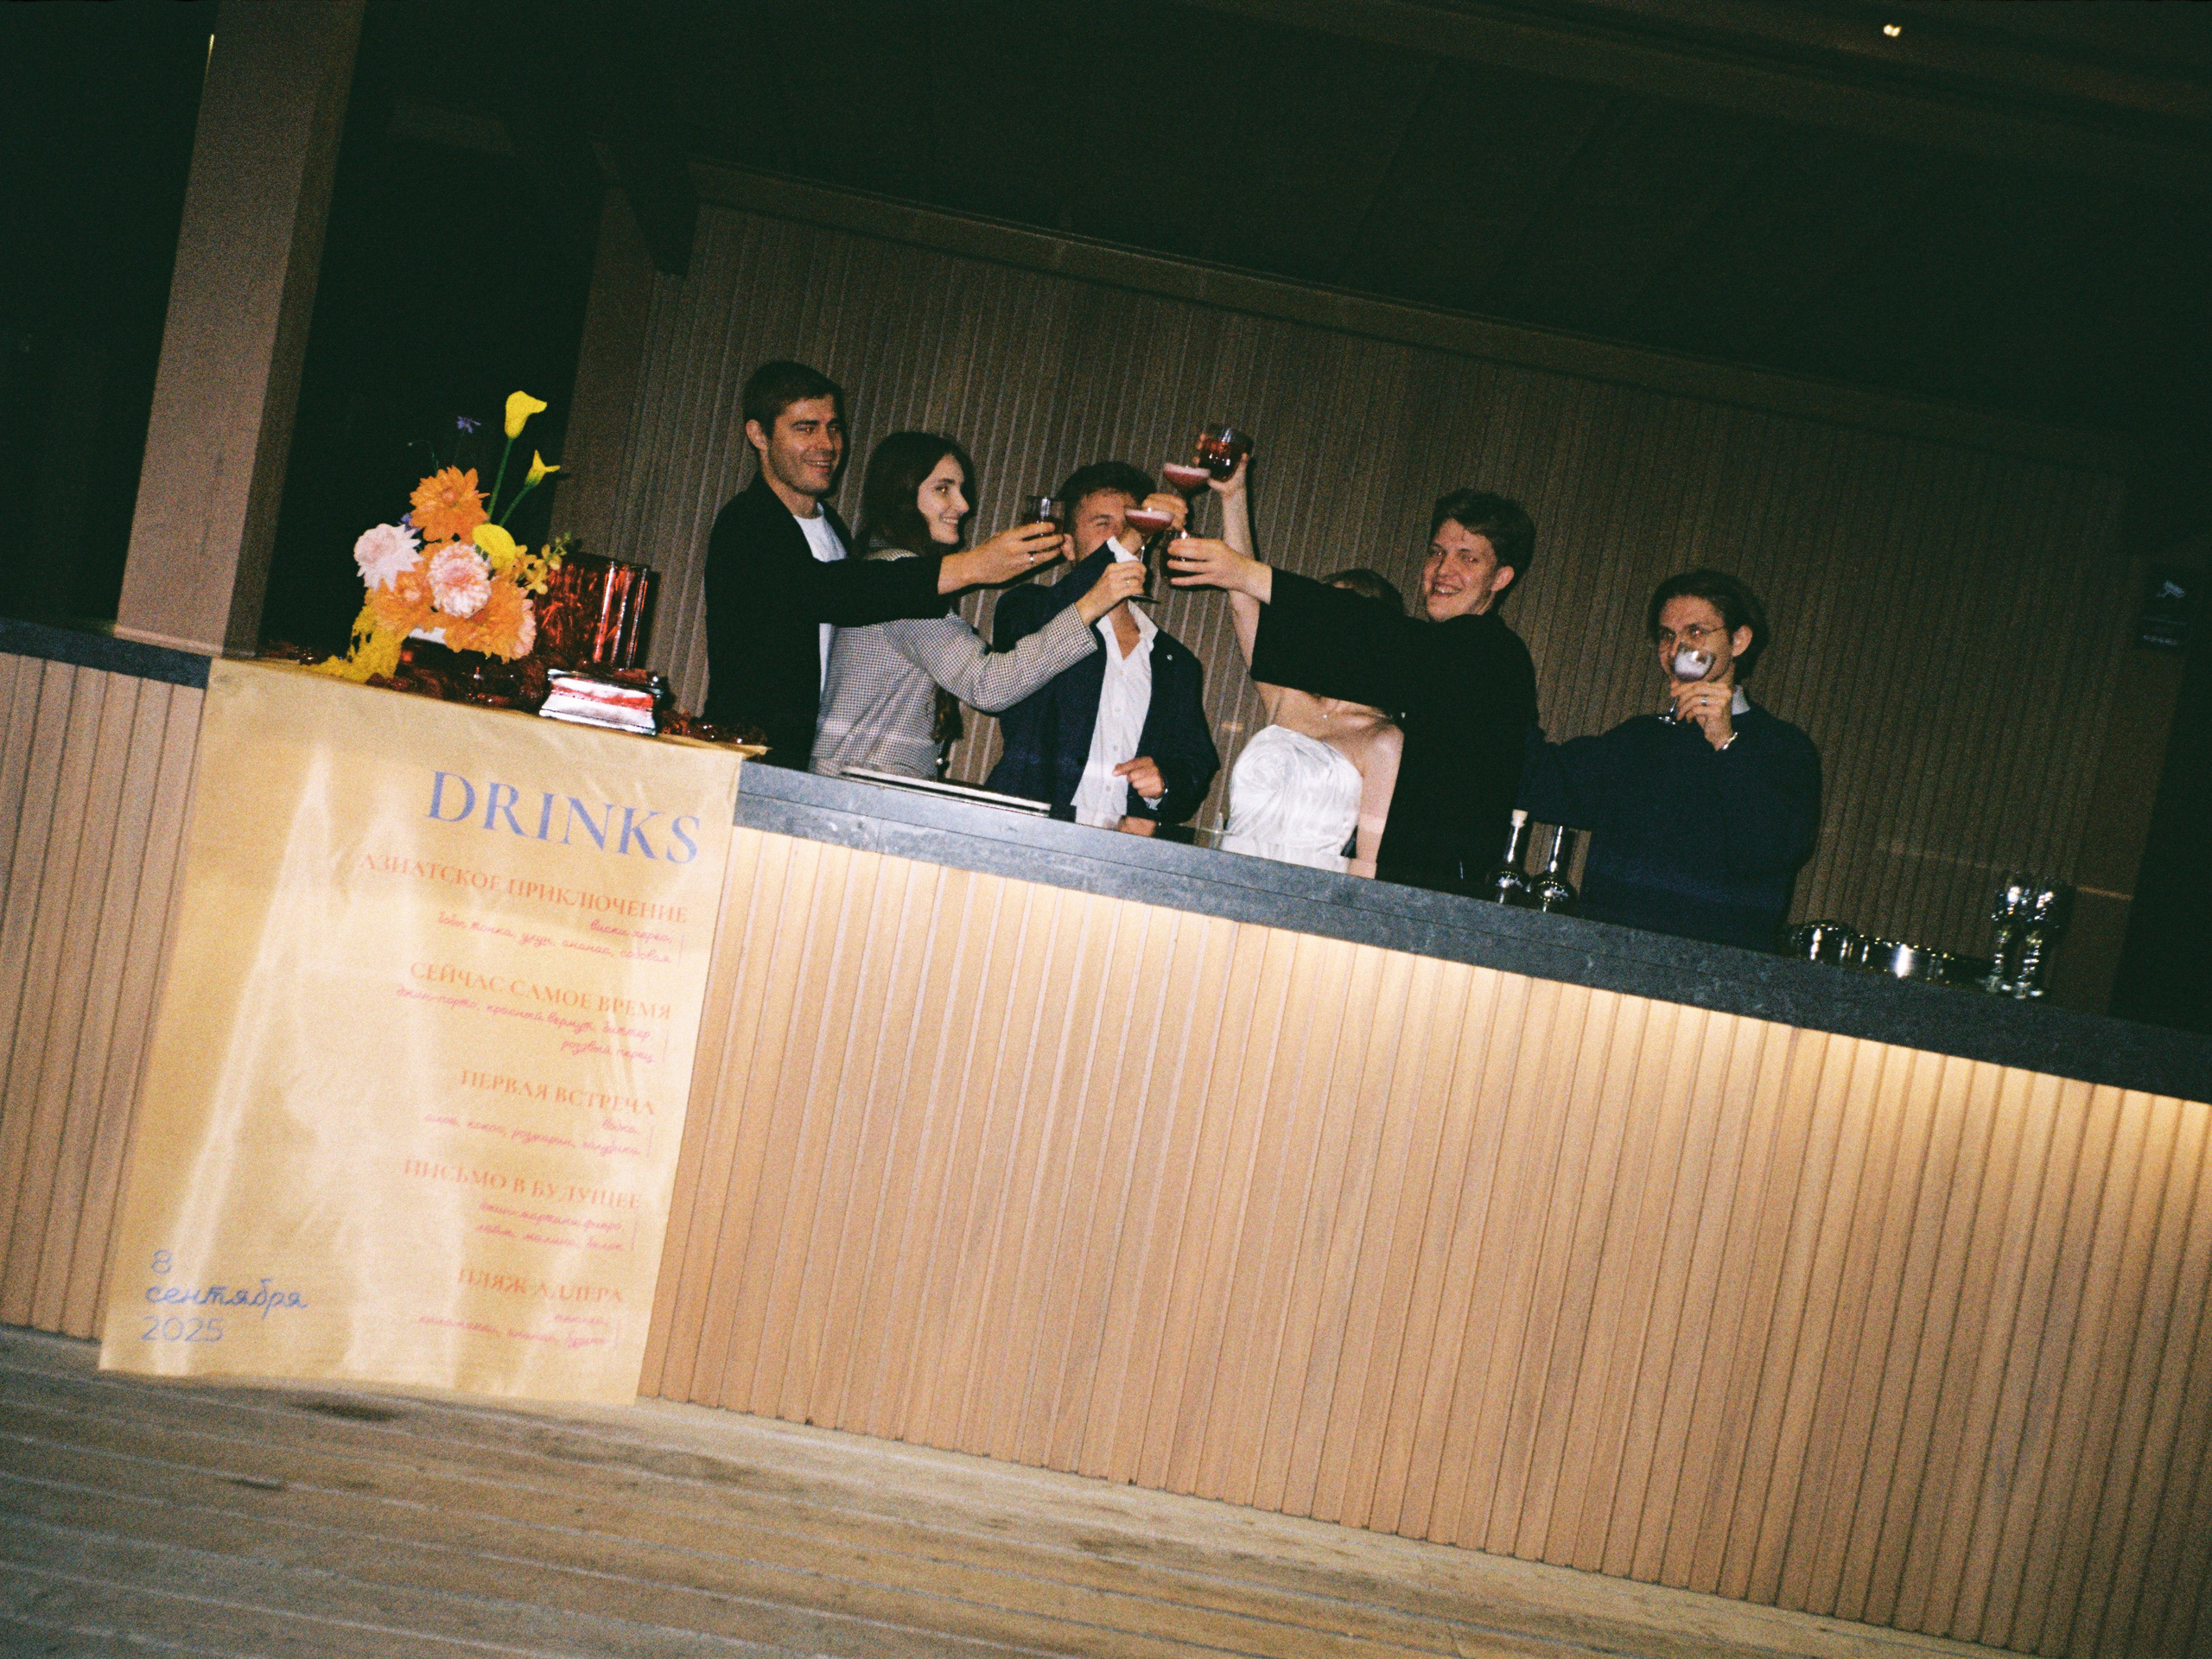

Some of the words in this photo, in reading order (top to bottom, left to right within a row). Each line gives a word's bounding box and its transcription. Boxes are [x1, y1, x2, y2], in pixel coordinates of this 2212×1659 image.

[425, 770, 700, 864] DRINKS
[359, 853, 502, 891] АЗИАТСКОЕ
[507, 878, 688, 924] ПРИКЛЮЧЕНИЕ
[410, 962, 505, 995] СЕЙЧАС
[510, 979, 594, 1010] САМОЕ
[598, 995, 671, 1020] ВРЕМЯ
[461, 1070, 548, 1100] ПЕРВАЯ
[555, 1086, 655, 1116] ВСТРЕЧА
[405, 1160, 507, 1189] ПИСЬМО
[513, 1177, 525, 1193] В
[532, 1179, 641, 1209] БУДУЩЕЕ
[151, 1249, 172, 1274] 8
[458, 1268, 527, 1294] ПЛЯЖ
[145, 1278, 308, 1320] сентября
[141, 1315, 224, 1342] 2025
